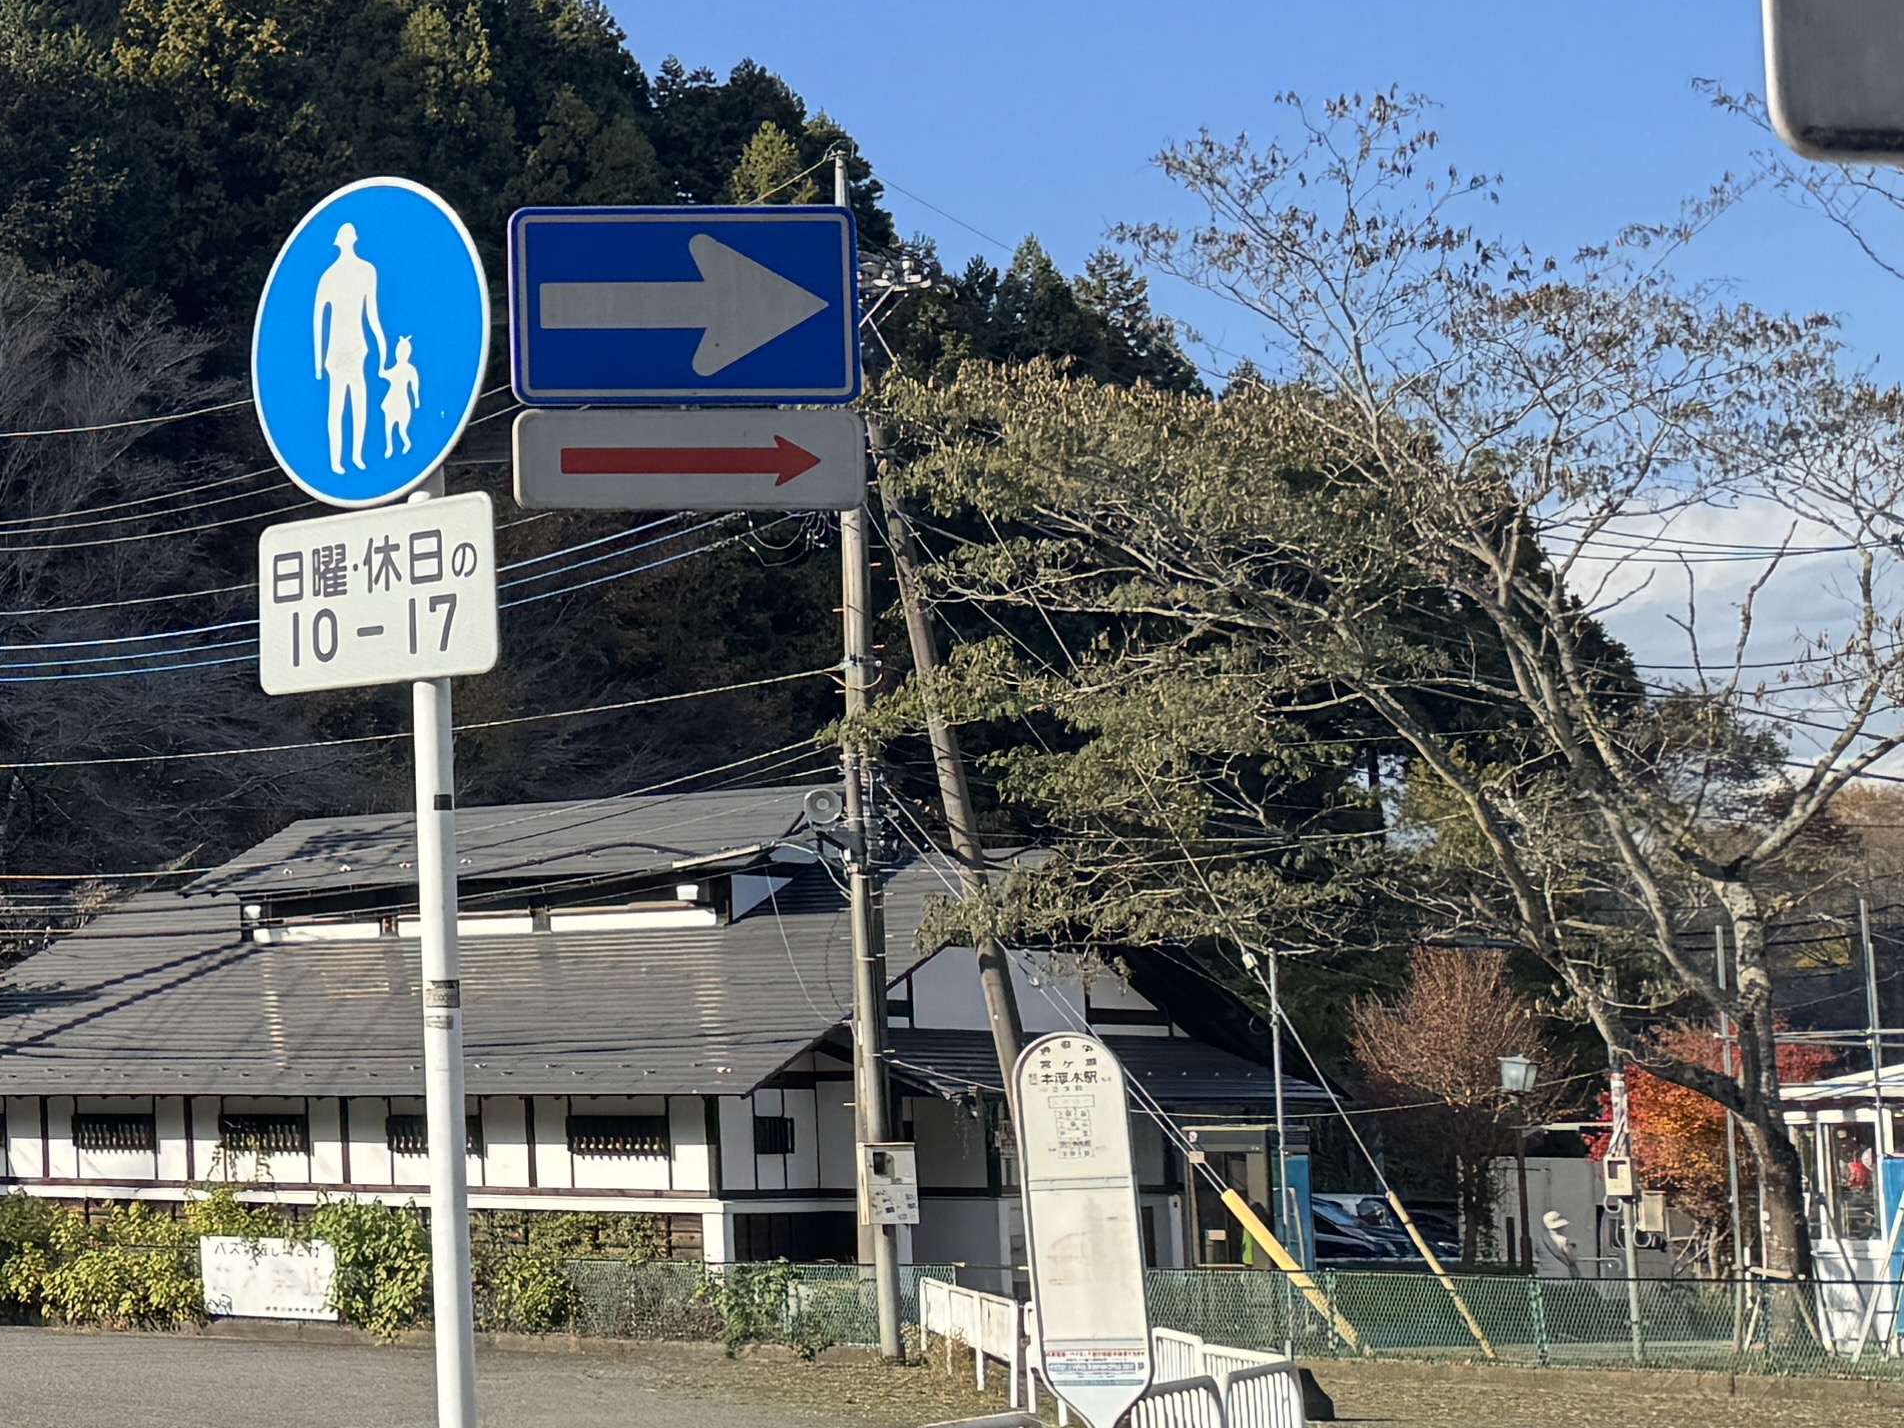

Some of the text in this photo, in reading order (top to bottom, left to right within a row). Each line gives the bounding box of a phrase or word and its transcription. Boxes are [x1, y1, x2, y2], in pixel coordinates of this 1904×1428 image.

[273, 529, 478, 604] 日曜・休日の
